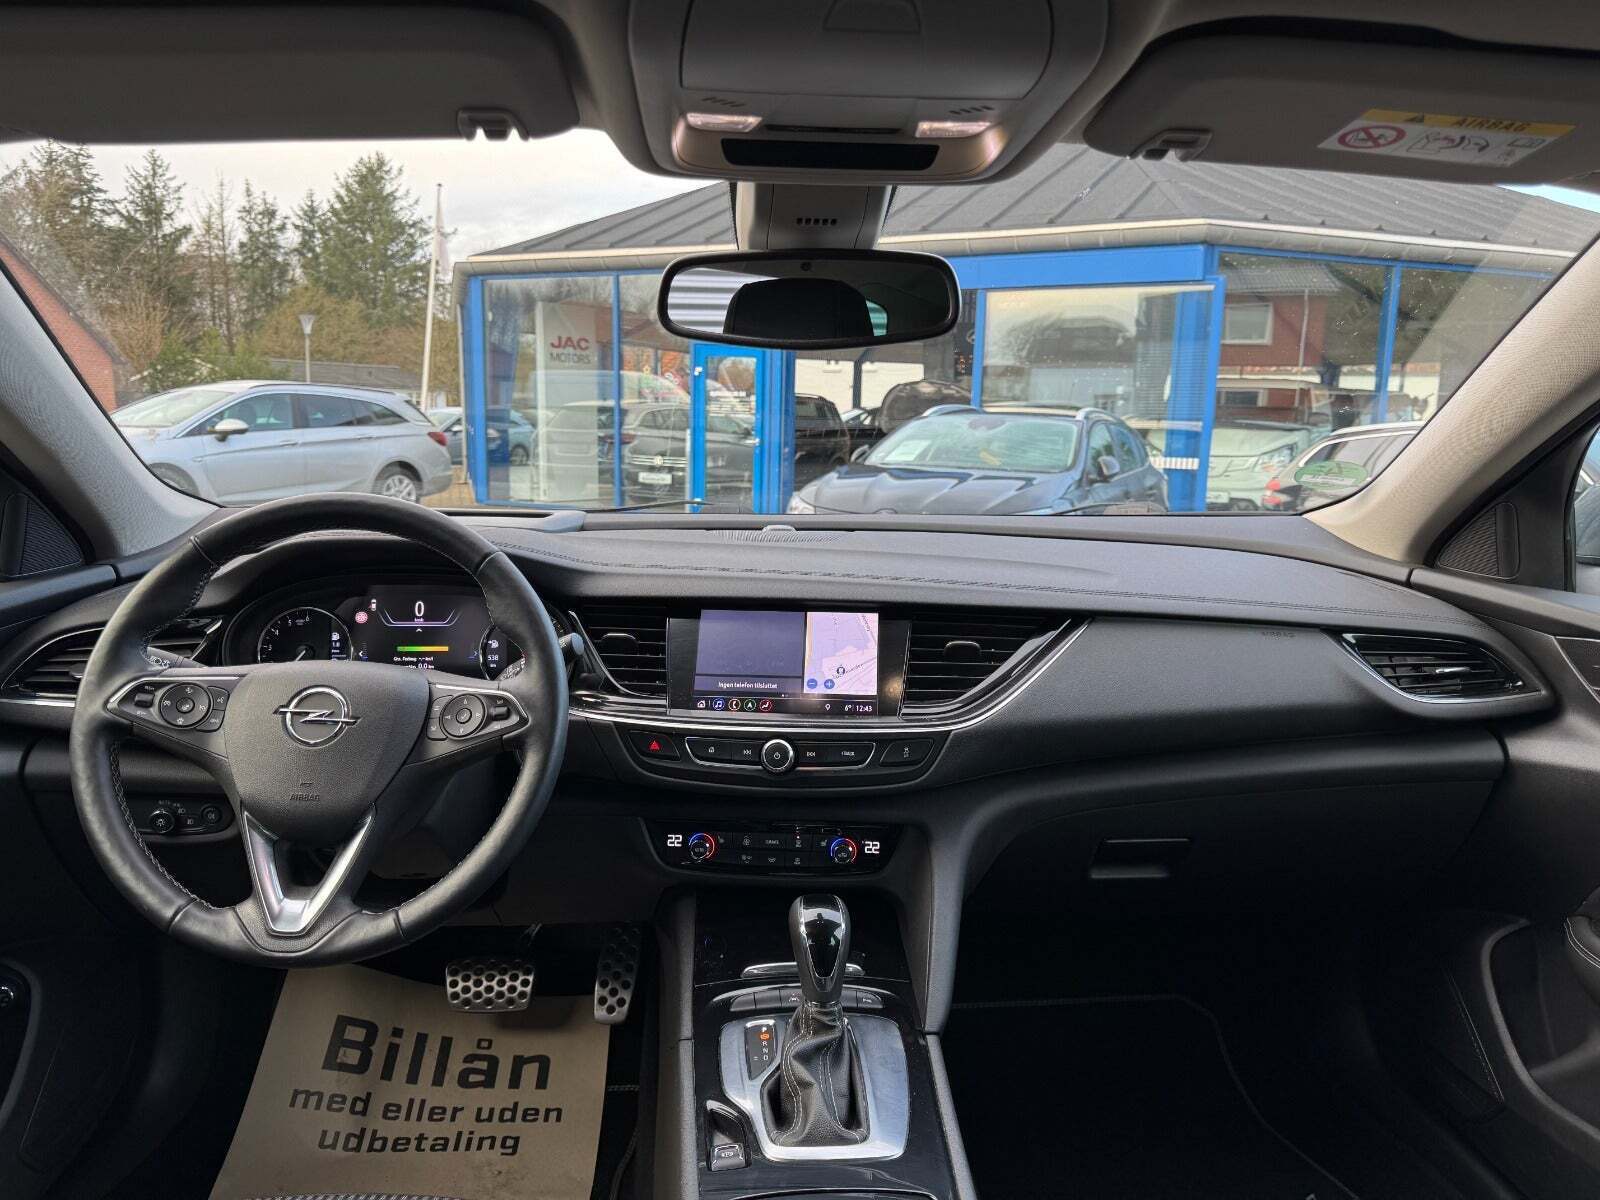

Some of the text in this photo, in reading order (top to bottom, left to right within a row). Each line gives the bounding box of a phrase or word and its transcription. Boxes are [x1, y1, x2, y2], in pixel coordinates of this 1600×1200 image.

[1452, 117, 1531, 132] AIRBAG
[550, 336, 590, 351] JAC
[549, 352, 592, 365] MOTORS
[414, 601, 425, 617] 0
[718, 682, 777, 690] Ingen telefon tilsluttet
[289, 793, 320, 801] AIRBAG
[666, 834, 683, 847] 22
[864, 841, 880, 854] 22
[322, 1014, 551, 1090] Billån
[289, 1088, 563, 1124] med eller uden
[318, 1127, 520, 1156] udbetaling
